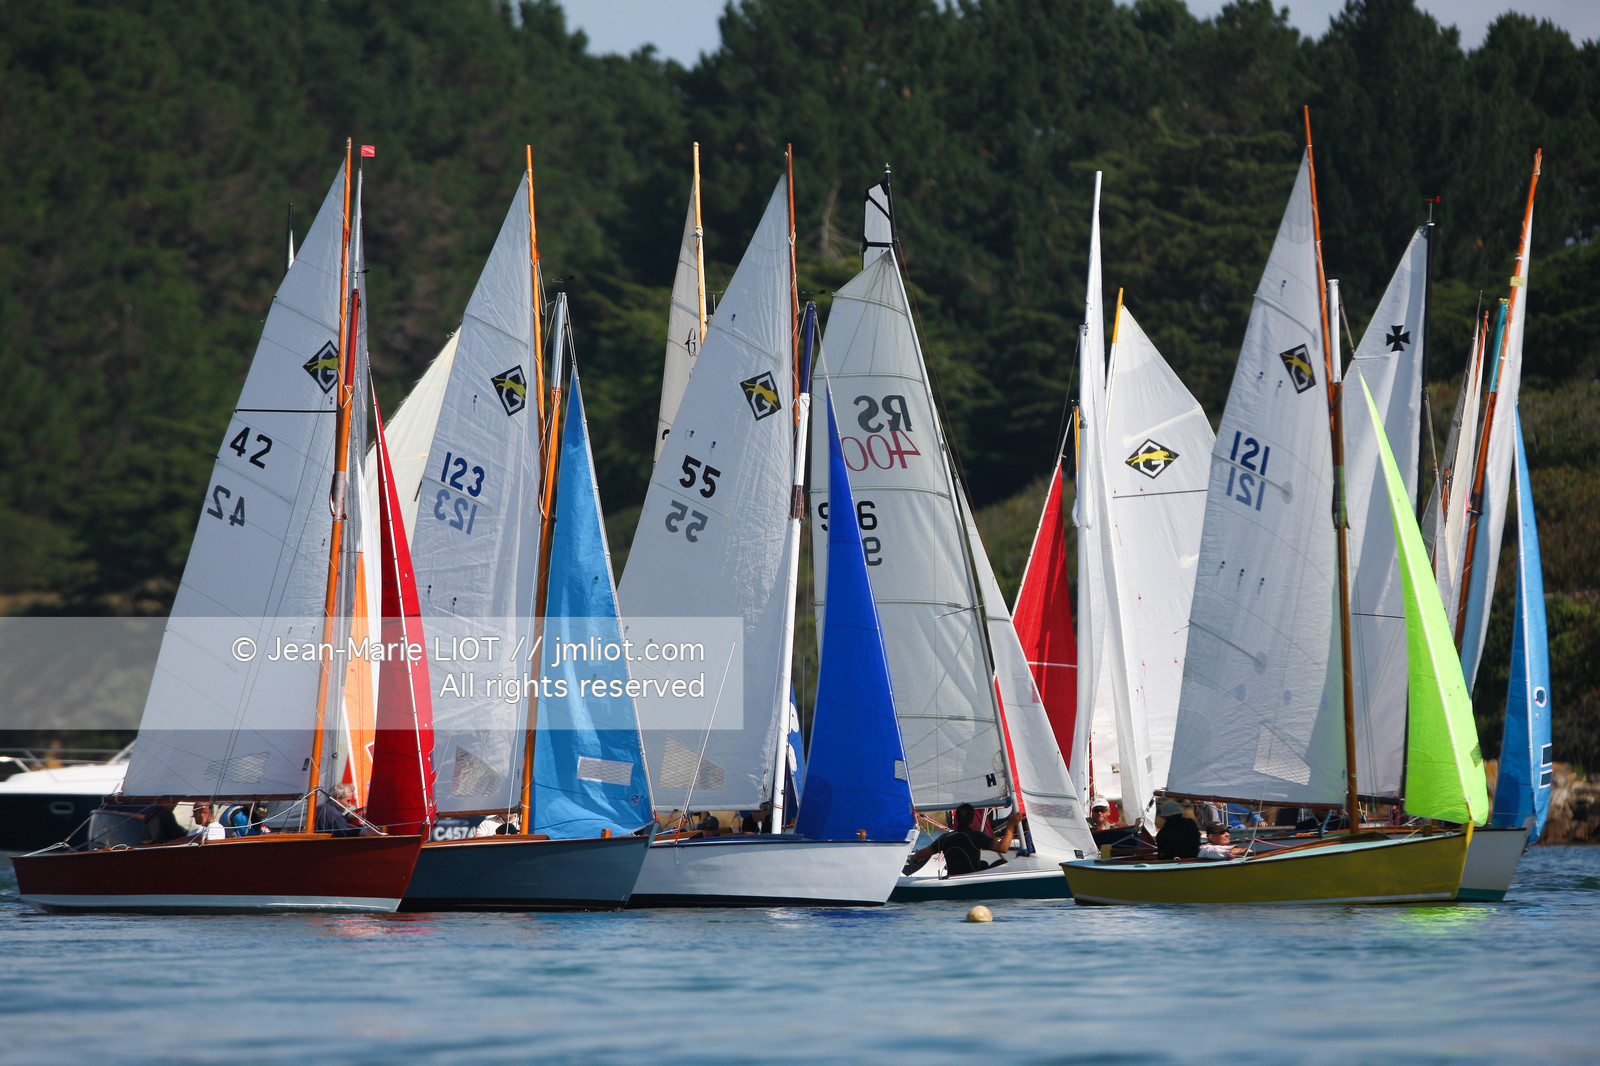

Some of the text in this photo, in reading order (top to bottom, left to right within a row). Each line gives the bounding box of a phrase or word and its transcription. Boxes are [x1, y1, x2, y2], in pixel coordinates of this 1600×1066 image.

[230, 426, 273, 469] 42
[1230, 430, 1270, 476] 121
[441, 451, 485, 497] 123
[679, 454, 721, 498] 55
